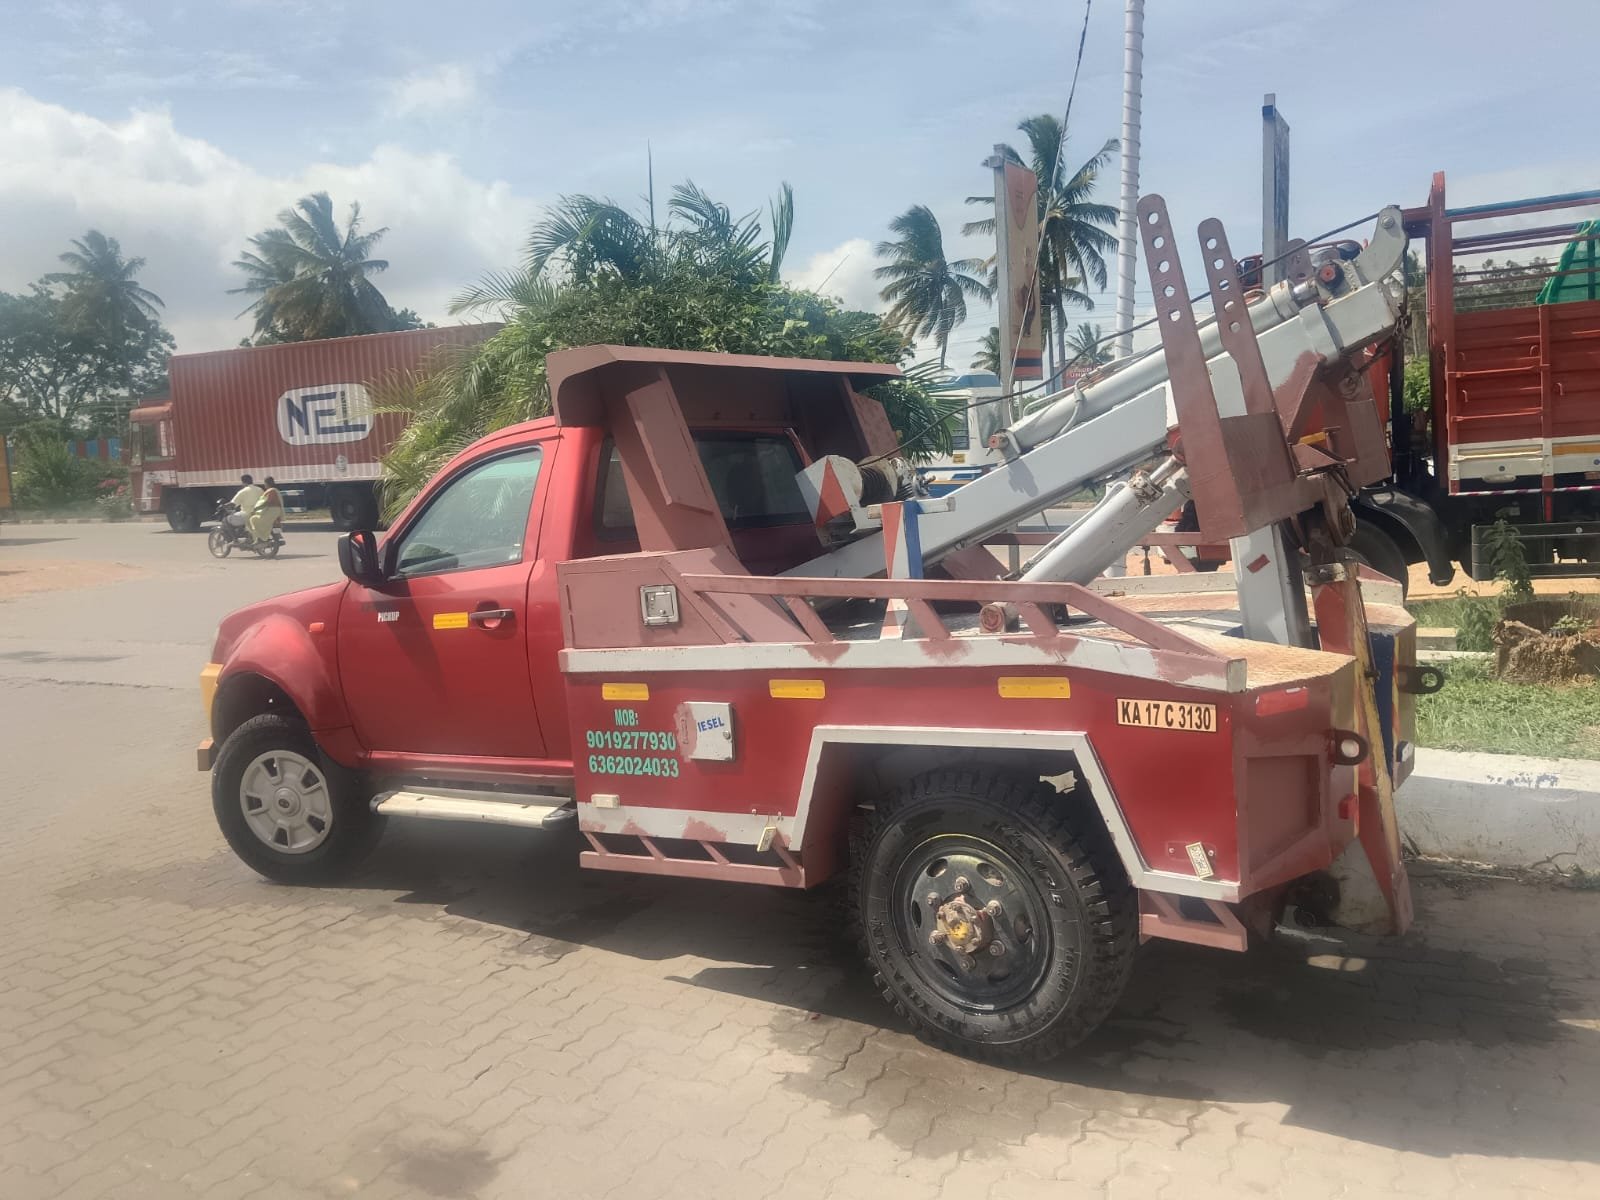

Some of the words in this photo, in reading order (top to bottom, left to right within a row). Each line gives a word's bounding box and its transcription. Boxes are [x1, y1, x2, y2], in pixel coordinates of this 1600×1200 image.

[377, 611, 400, 623] PICKUP
[614, 709, 639, 726] MOB:
[698, 717, 724, 732] IESEL
[1122, 702, 1141, 723] KA
[1145, 703, 1160, 725] 17
[1165, 704, 1174, 727] C
[1178, 705, 1211, 729] 3130
[587, 731, 676, 750] 9019277930
[589, 756, 679, 777] 6362024033
